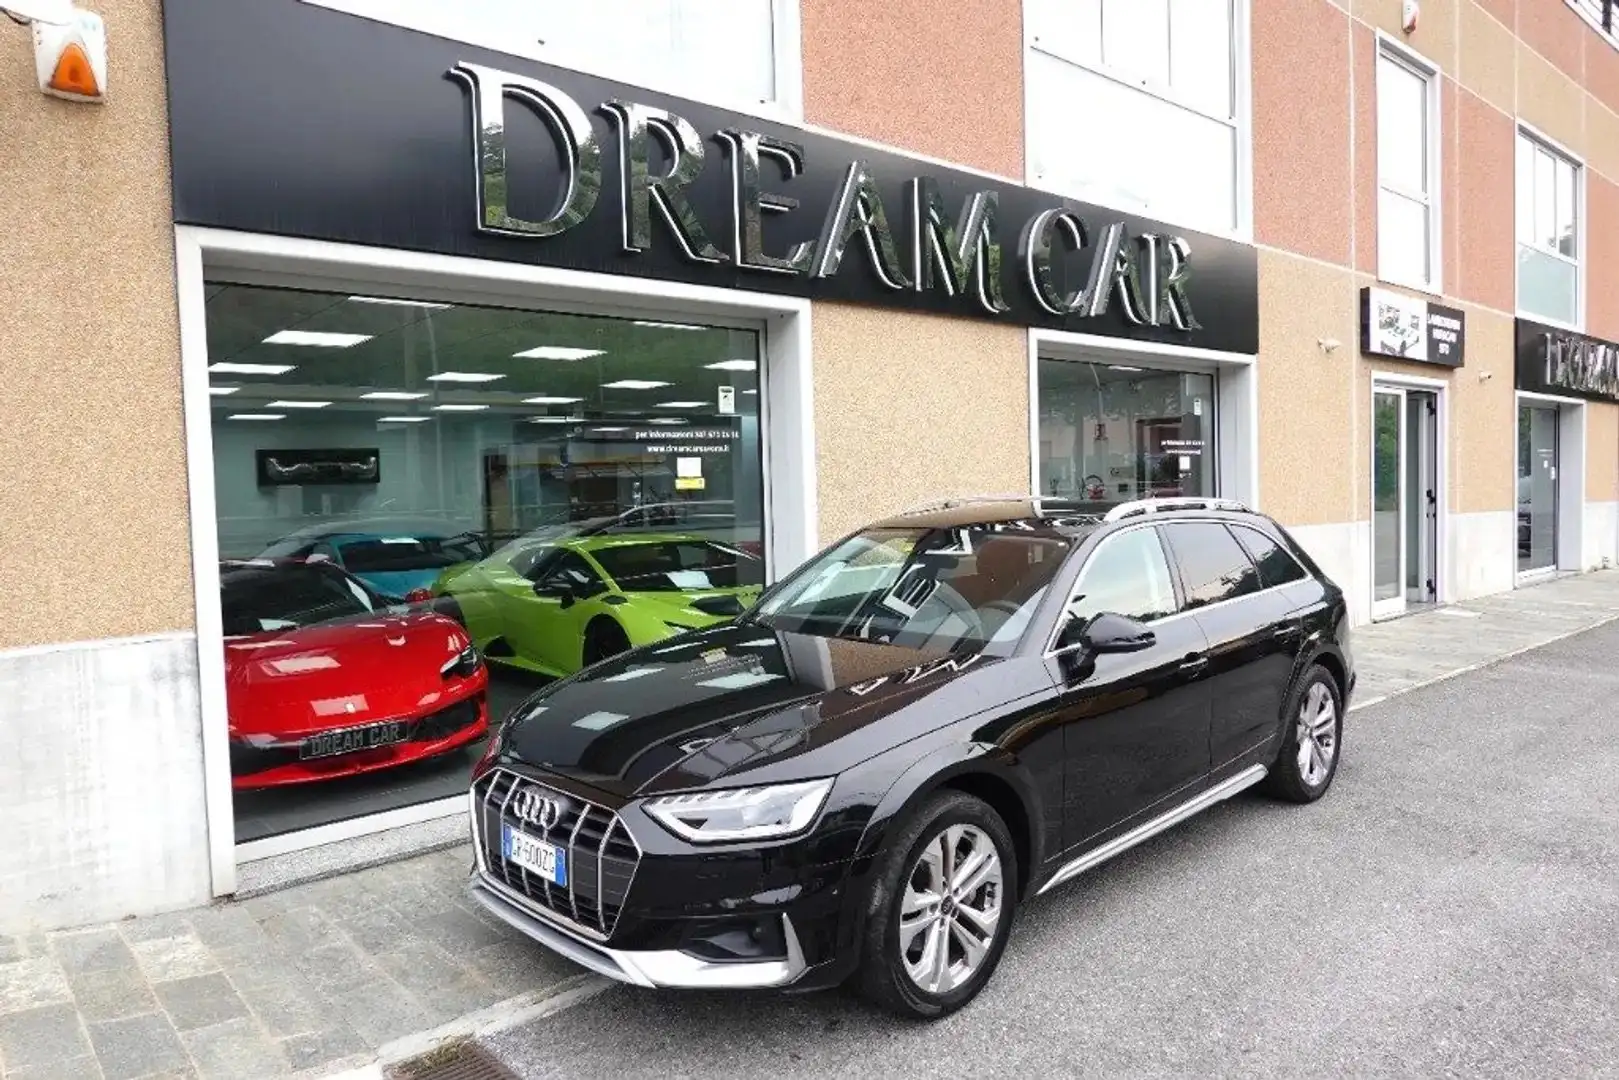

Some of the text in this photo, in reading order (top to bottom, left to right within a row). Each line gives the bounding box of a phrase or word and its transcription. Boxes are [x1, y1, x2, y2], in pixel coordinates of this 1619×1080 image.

[448, 60, 1201, 331] DREAM CAR
[649, 429, 694, 439] informazioni
[311, 724, 400, 756] DREAM CAR
